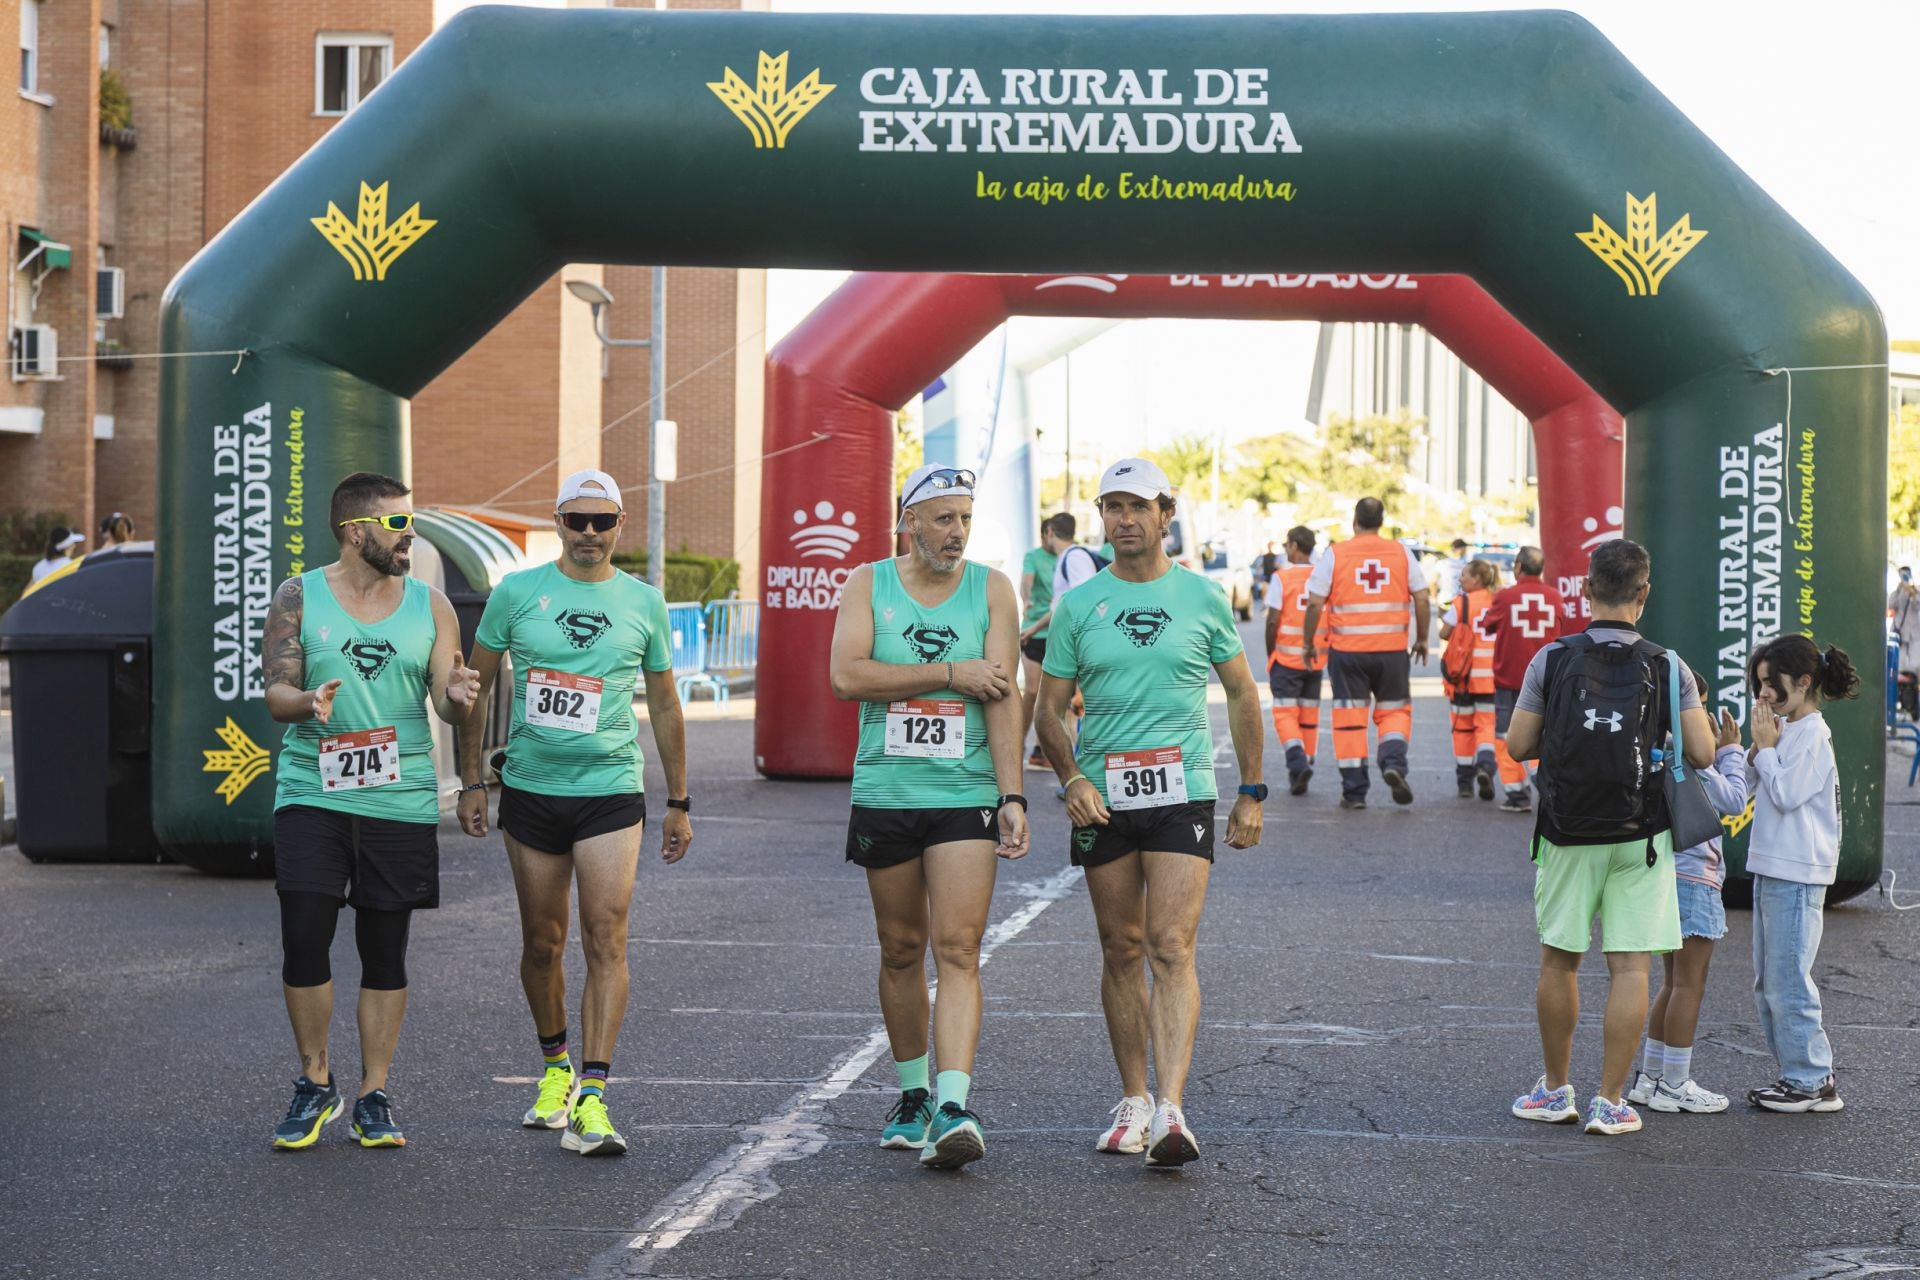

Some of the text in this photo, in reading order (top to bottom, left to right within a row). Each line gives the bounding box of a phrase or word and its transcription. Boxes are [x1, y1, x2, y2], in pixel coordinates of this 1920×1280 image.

[860, 68, 1268, 109] CAJA RURAL DE
[859, 111, 1303, 153] EXTREMADURA
[976, 170, 1297, 205] La caja de Extremadura
[283, 406, 305, 527] Extremadura
[1720, 446, 1749, 498] DE
[1793, 427, 1816, 552] Extremadura
[244, 402, 272, 701] EXTREMADURA
[285, 531, 305, 555] de
[1752, 423, 1783, 646] REMADURA
[214, 425, 243, 701] CAJA RURAL DE
[768, 566, 853, 589] DIPUTAC
[1718, 505, 1748, 632] RURAL
[1795, 556, 1815, 581] de
[767, 588, 842, 609] DE BADA
[1796, 584, 1817, 625] caja
[537, 687, 585, 719] 362
[902, 717, 946, 745] 123
[338, 747, 382, 777] 274
[1123, 767, 1168, 798] 391
